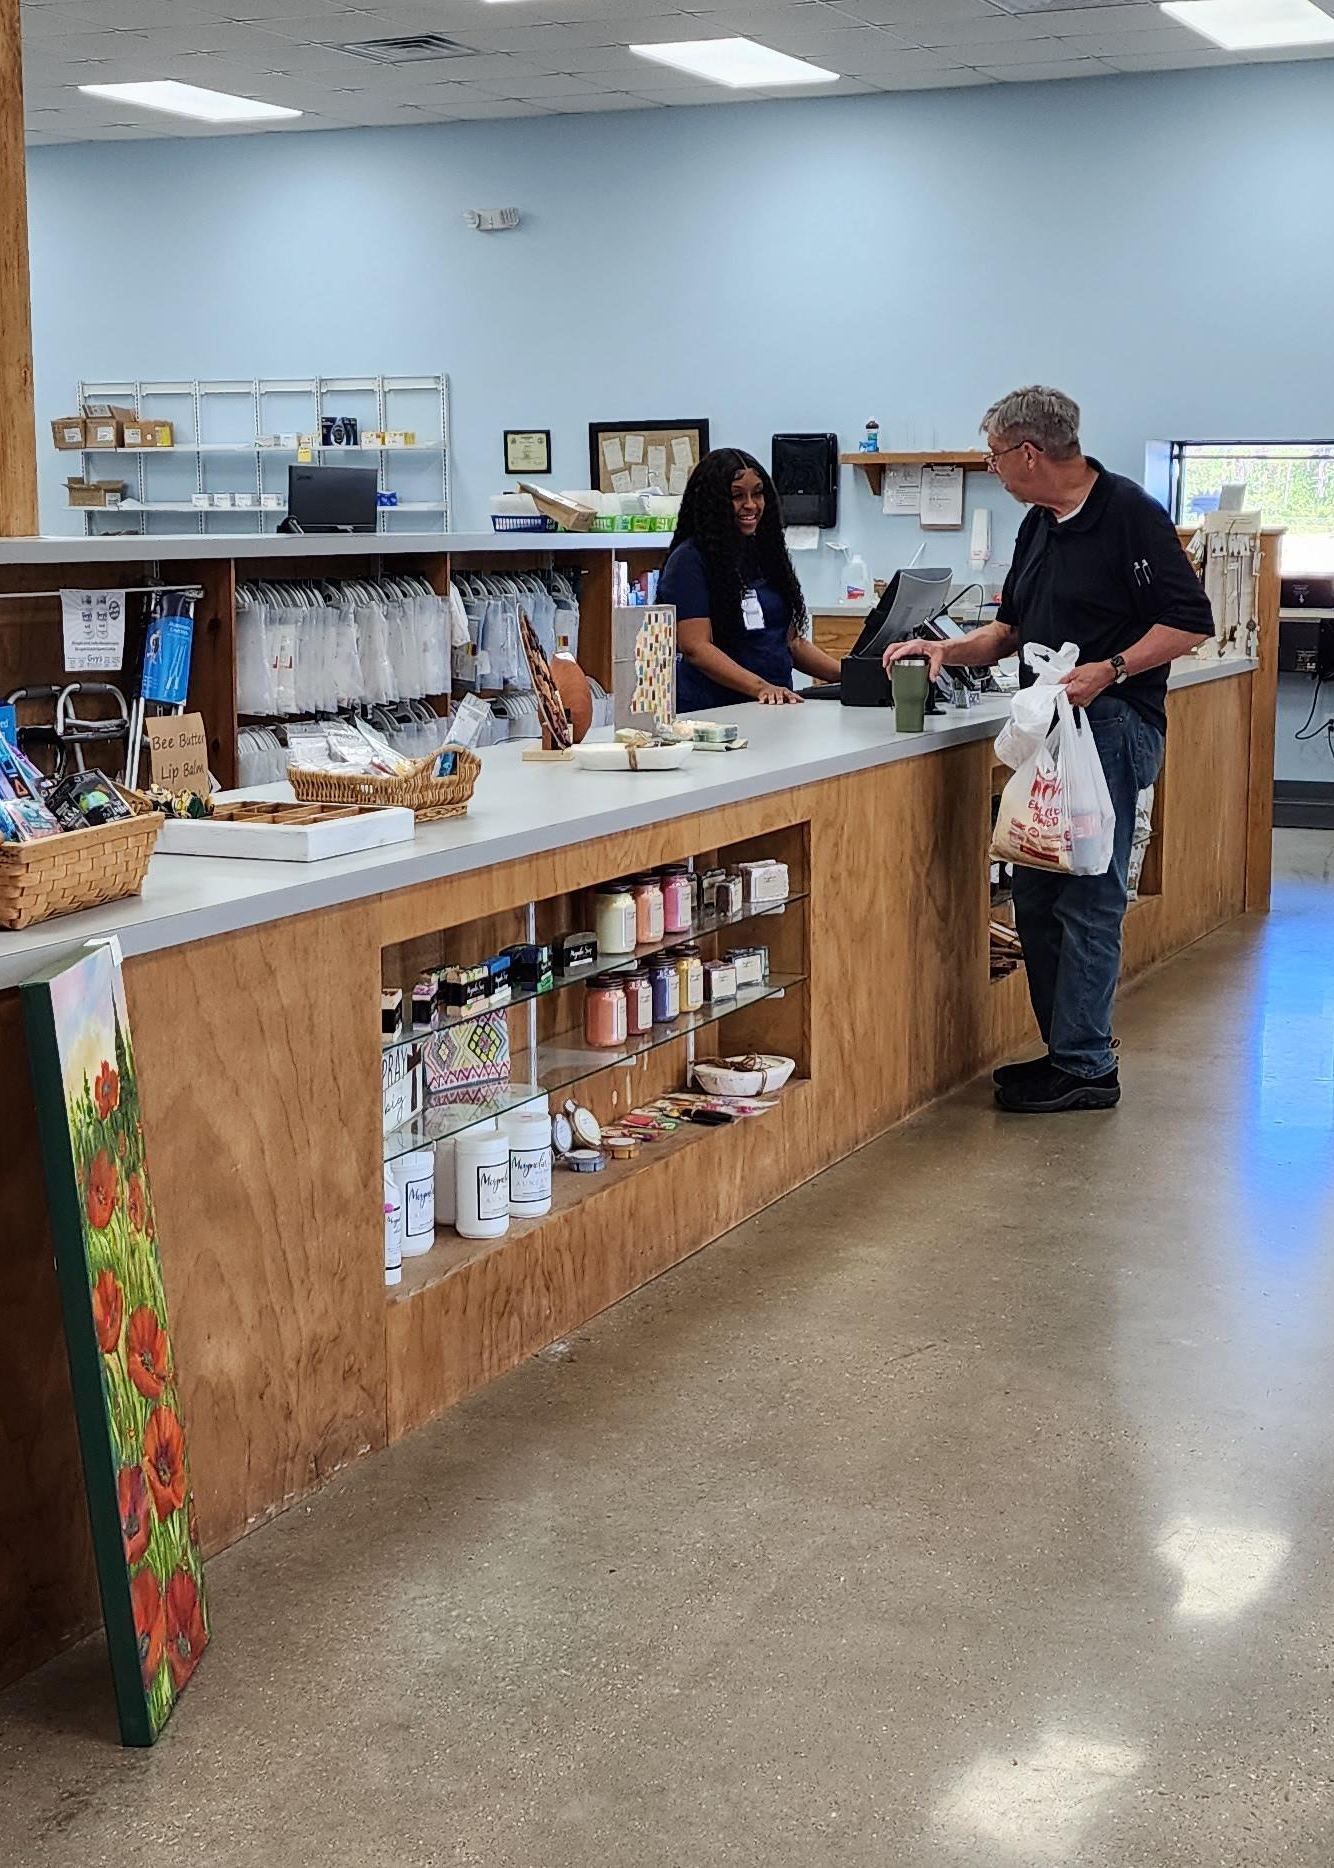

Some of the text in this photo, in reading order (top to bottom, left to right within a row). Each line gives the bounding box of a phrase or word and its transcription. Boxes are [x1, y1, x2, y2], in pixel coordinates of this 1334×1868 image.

[152, 732, 205, 751] Bee Butter
[161, 760, 205, 784] Lip Balm
